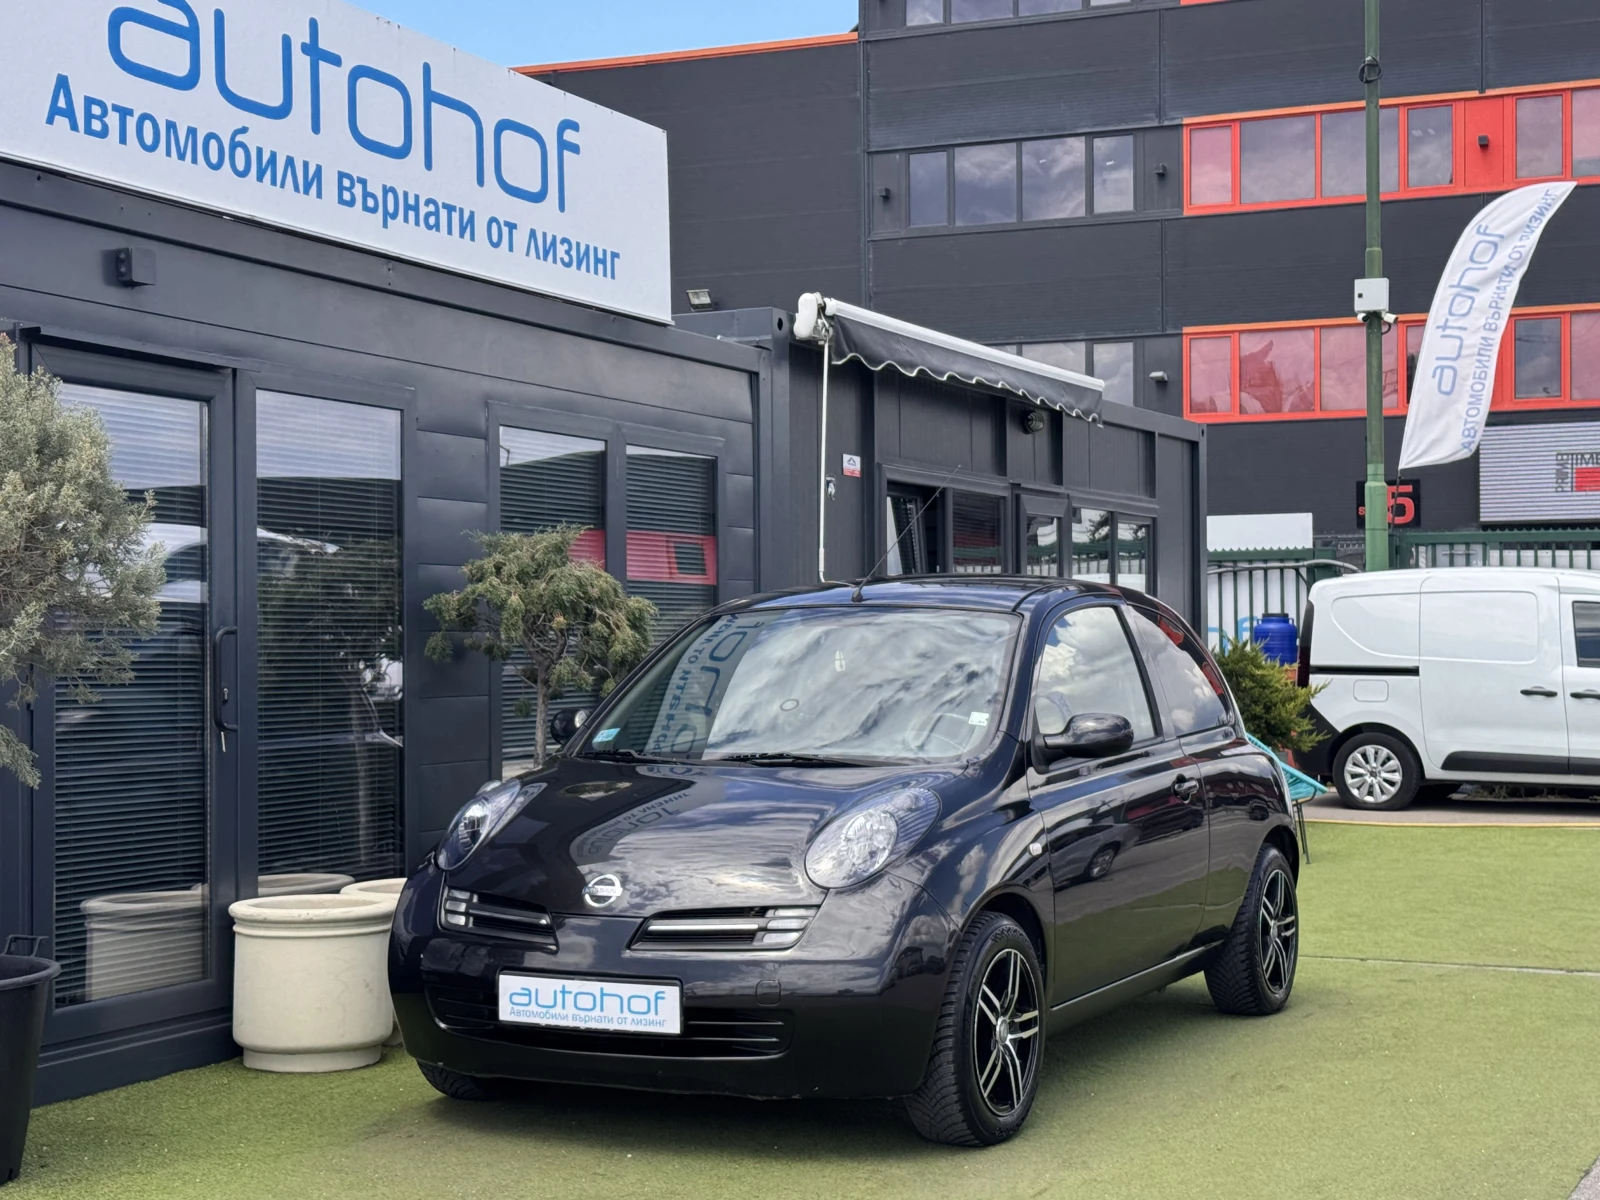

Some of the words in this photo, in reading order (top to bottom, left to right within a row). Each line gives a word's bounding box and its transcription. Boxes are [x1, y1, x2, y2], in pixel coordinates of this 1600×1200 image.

[45, 73, 324, 200] Автомобили
[336, 169, 476, 242] върнати
[486, 217, 518, 254] от
[525, 228, 621, 280] лизинг
[107, 0, 581, 213] autohof
[1432, 223, 1505, 396] autohof
[1460, 336, 1496, 452] АВТОМОБИЛИ
[1483, 263, 1518, 333] ВЪРНАТИ
[509, 984, 666, 1016] autohof
[509, 1006, 569, 1021] Автомобили
[571, 1013, 614, 1024] върнати
[616, 1017, 628, 1025] от
[631, 1018, 667, 1028] лизинг
